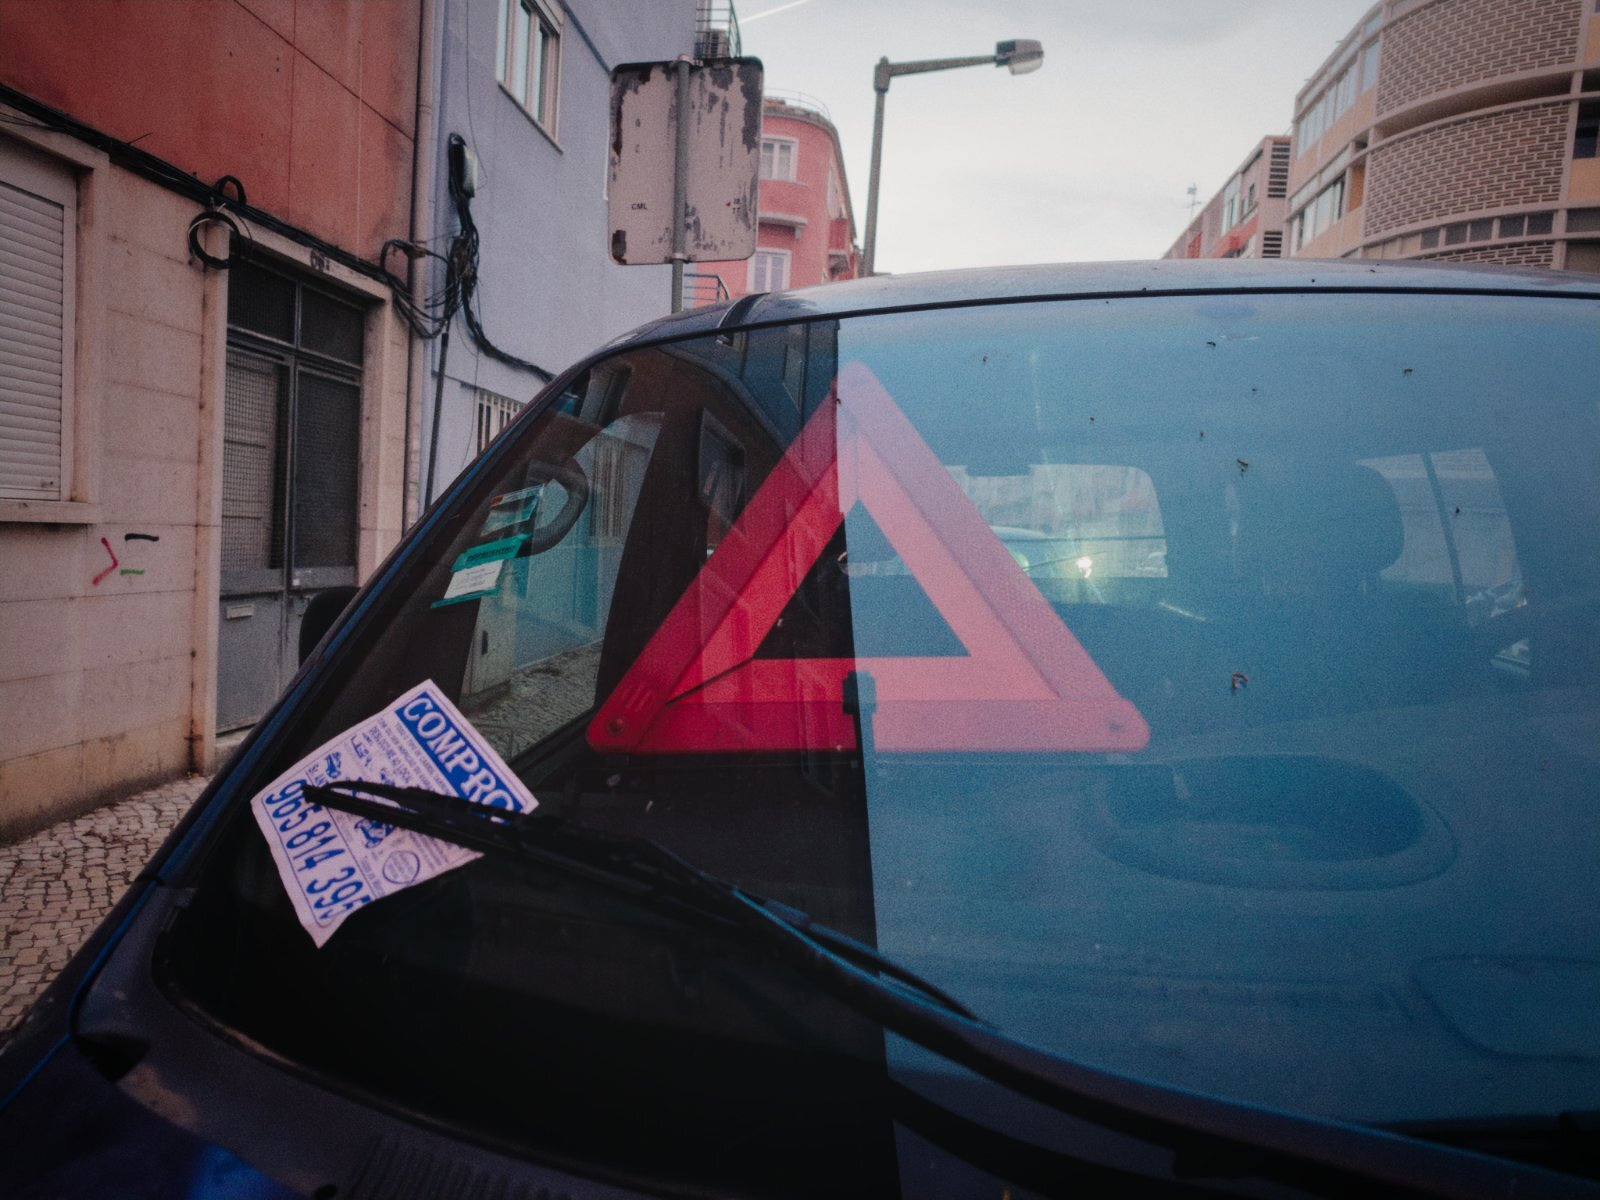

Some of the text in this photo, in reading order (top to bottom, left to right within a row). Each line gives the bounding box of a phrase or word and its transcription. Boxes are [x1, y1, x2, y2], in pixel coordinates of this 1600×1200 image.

[402, 696, 516, 812] COMPRO
[265, 778, 371, 920] 965 814 395
